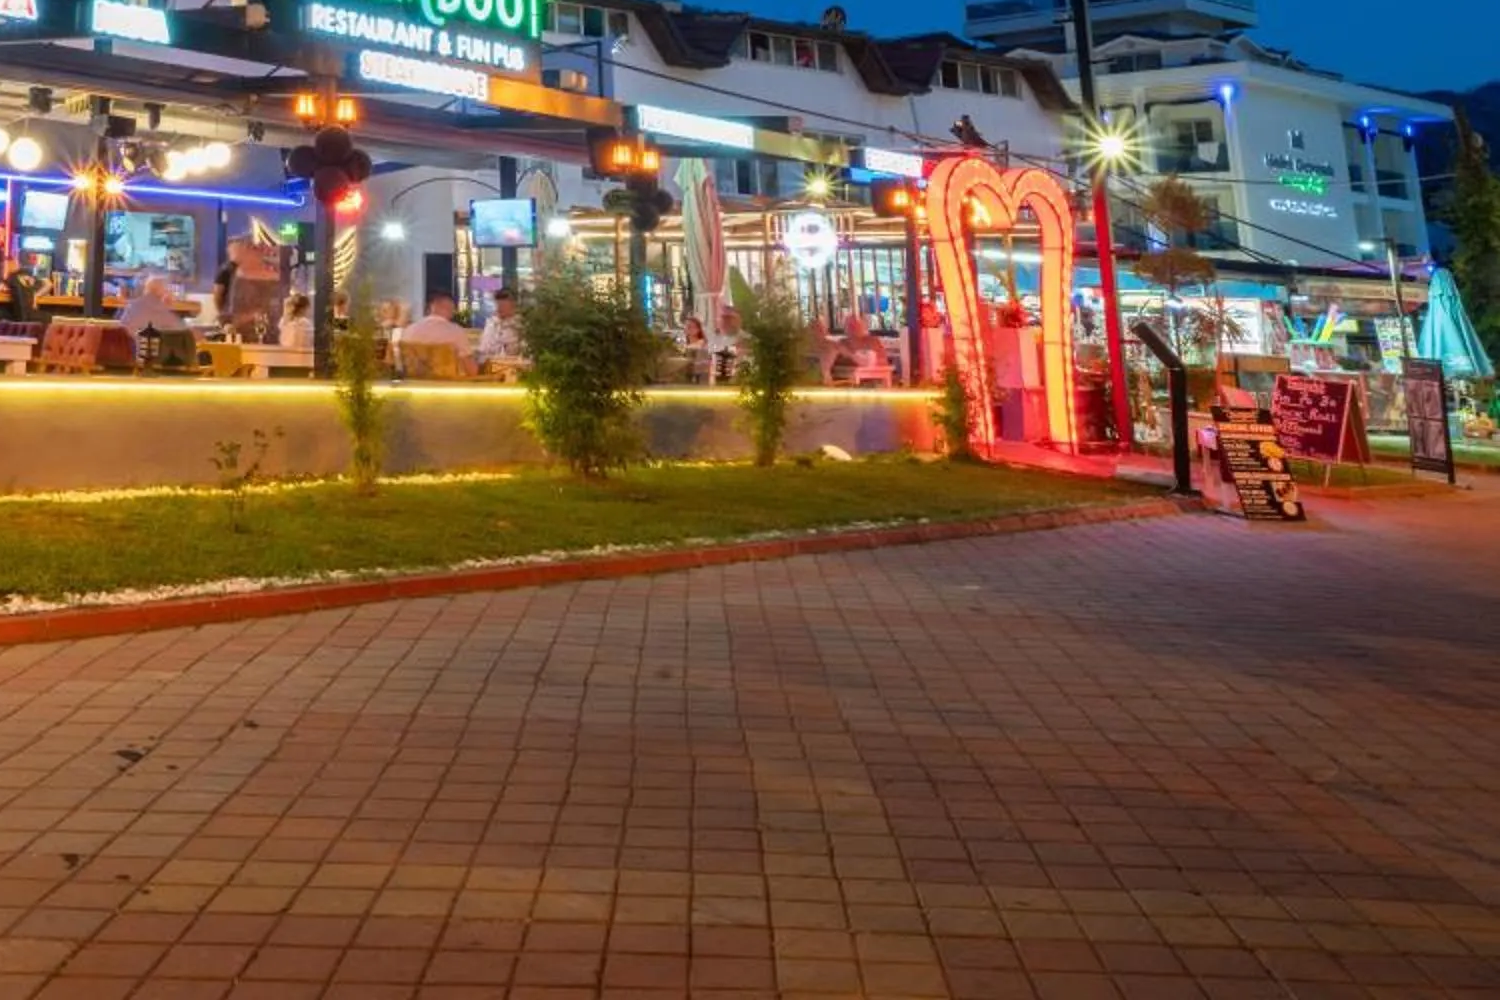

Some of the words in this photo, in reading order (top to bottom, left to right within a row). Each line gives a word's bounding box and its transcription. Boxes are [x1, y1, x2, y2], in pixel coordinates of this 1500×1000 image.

[311, 3, 433, 52] RESTAURANT
[437, 31, 452, 56] &
[456, 34, 492, 64] FUN
[493, 42, 525, 71] PUB
